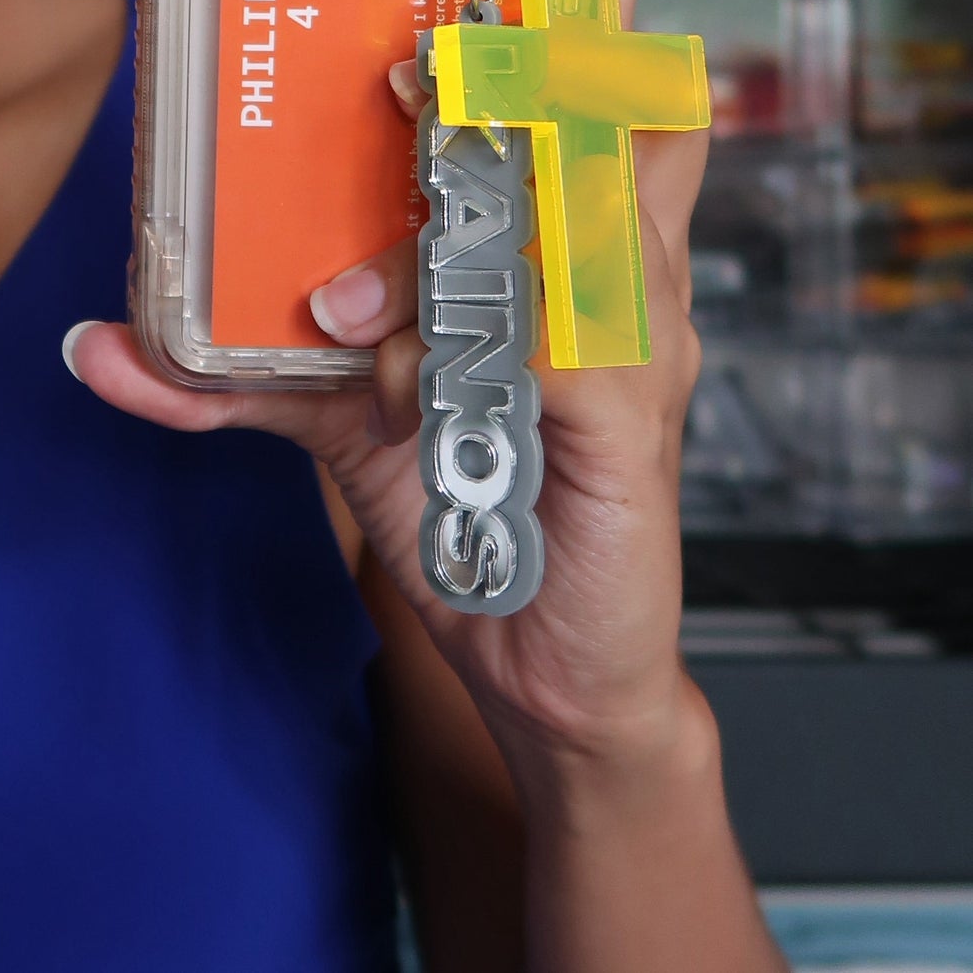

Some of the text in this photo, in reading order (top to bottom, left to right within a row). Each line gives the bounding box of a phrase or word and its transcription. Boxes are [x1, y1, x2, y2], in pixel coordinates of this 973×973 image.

[414, 14, 427, 22] I
[408, 188, 420, 204] is
[406, 213, 419, 228] it
